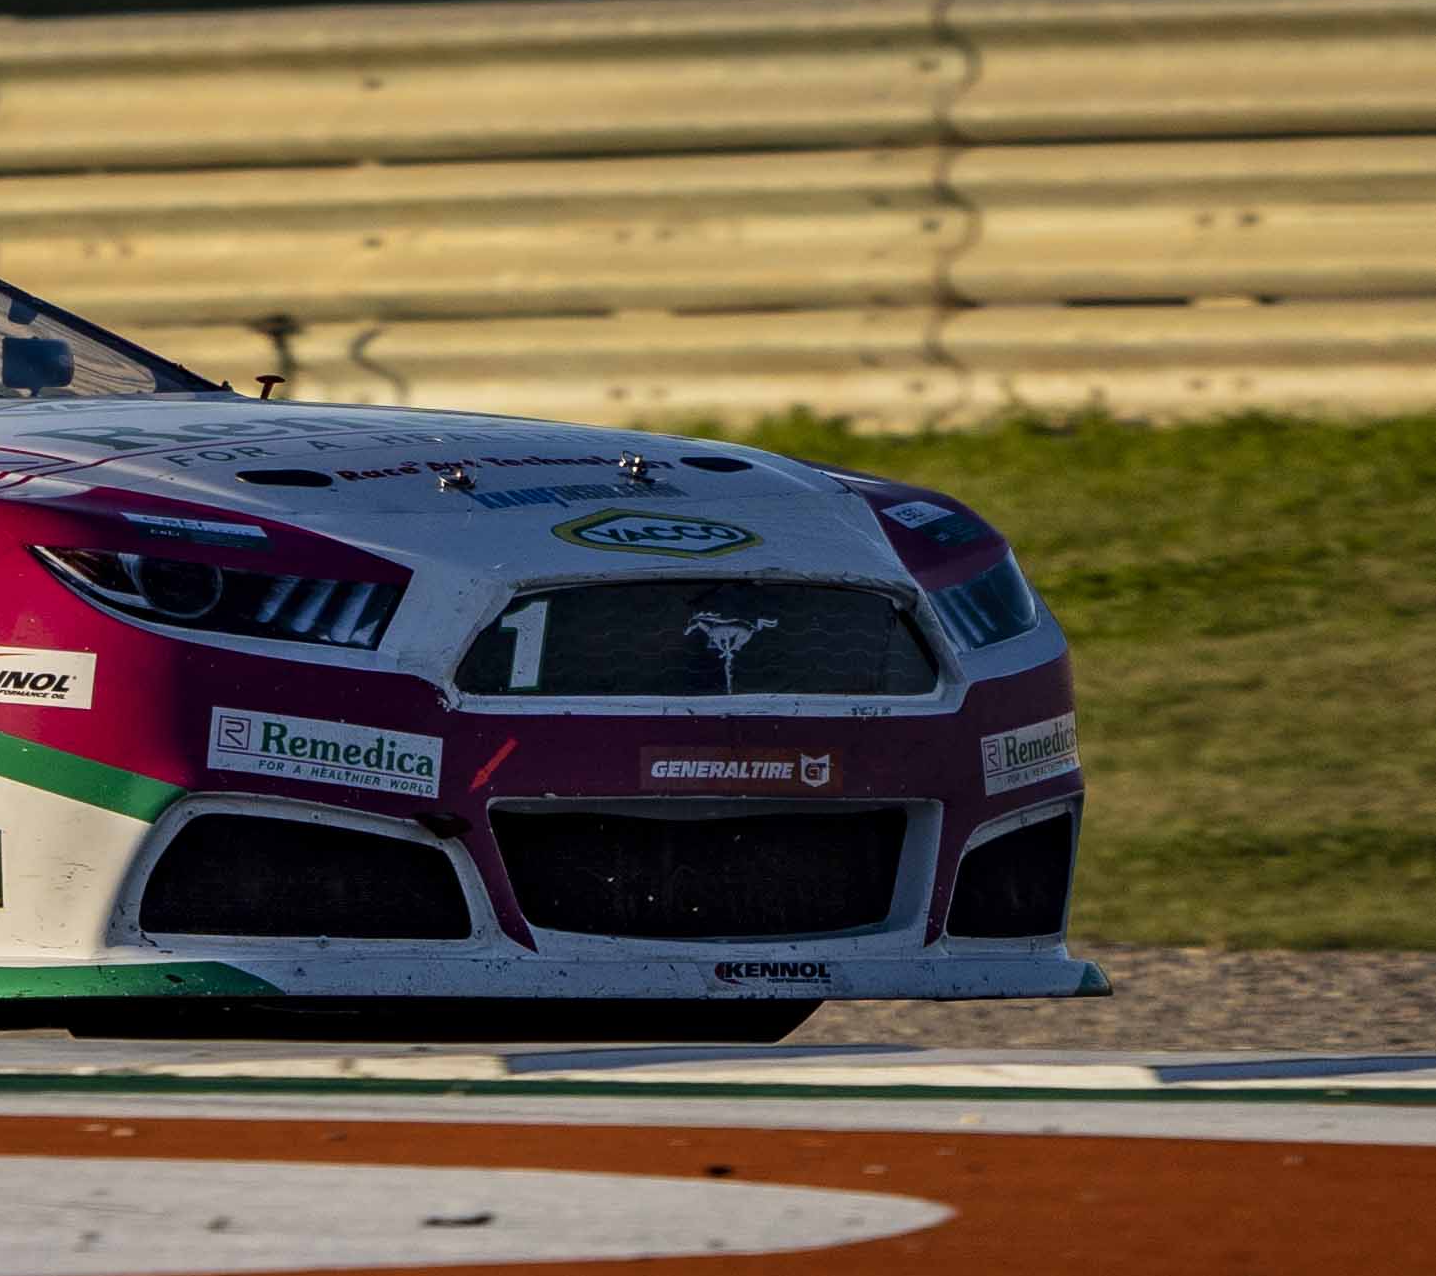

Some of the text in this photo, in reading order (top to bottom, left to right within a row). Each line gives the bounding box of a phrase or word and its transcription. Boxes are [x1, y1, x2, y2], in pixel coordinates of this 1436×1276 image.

[586, 525, 738, 543] YACCO
[499, 599, 553, 691] 1
[259, 720, 435, 778] Remedica
[258, 759, 285, 773] FOR
[310, 766, 381, 788] HEALTHIER
[723, 962, 831, 978] KENNOL
